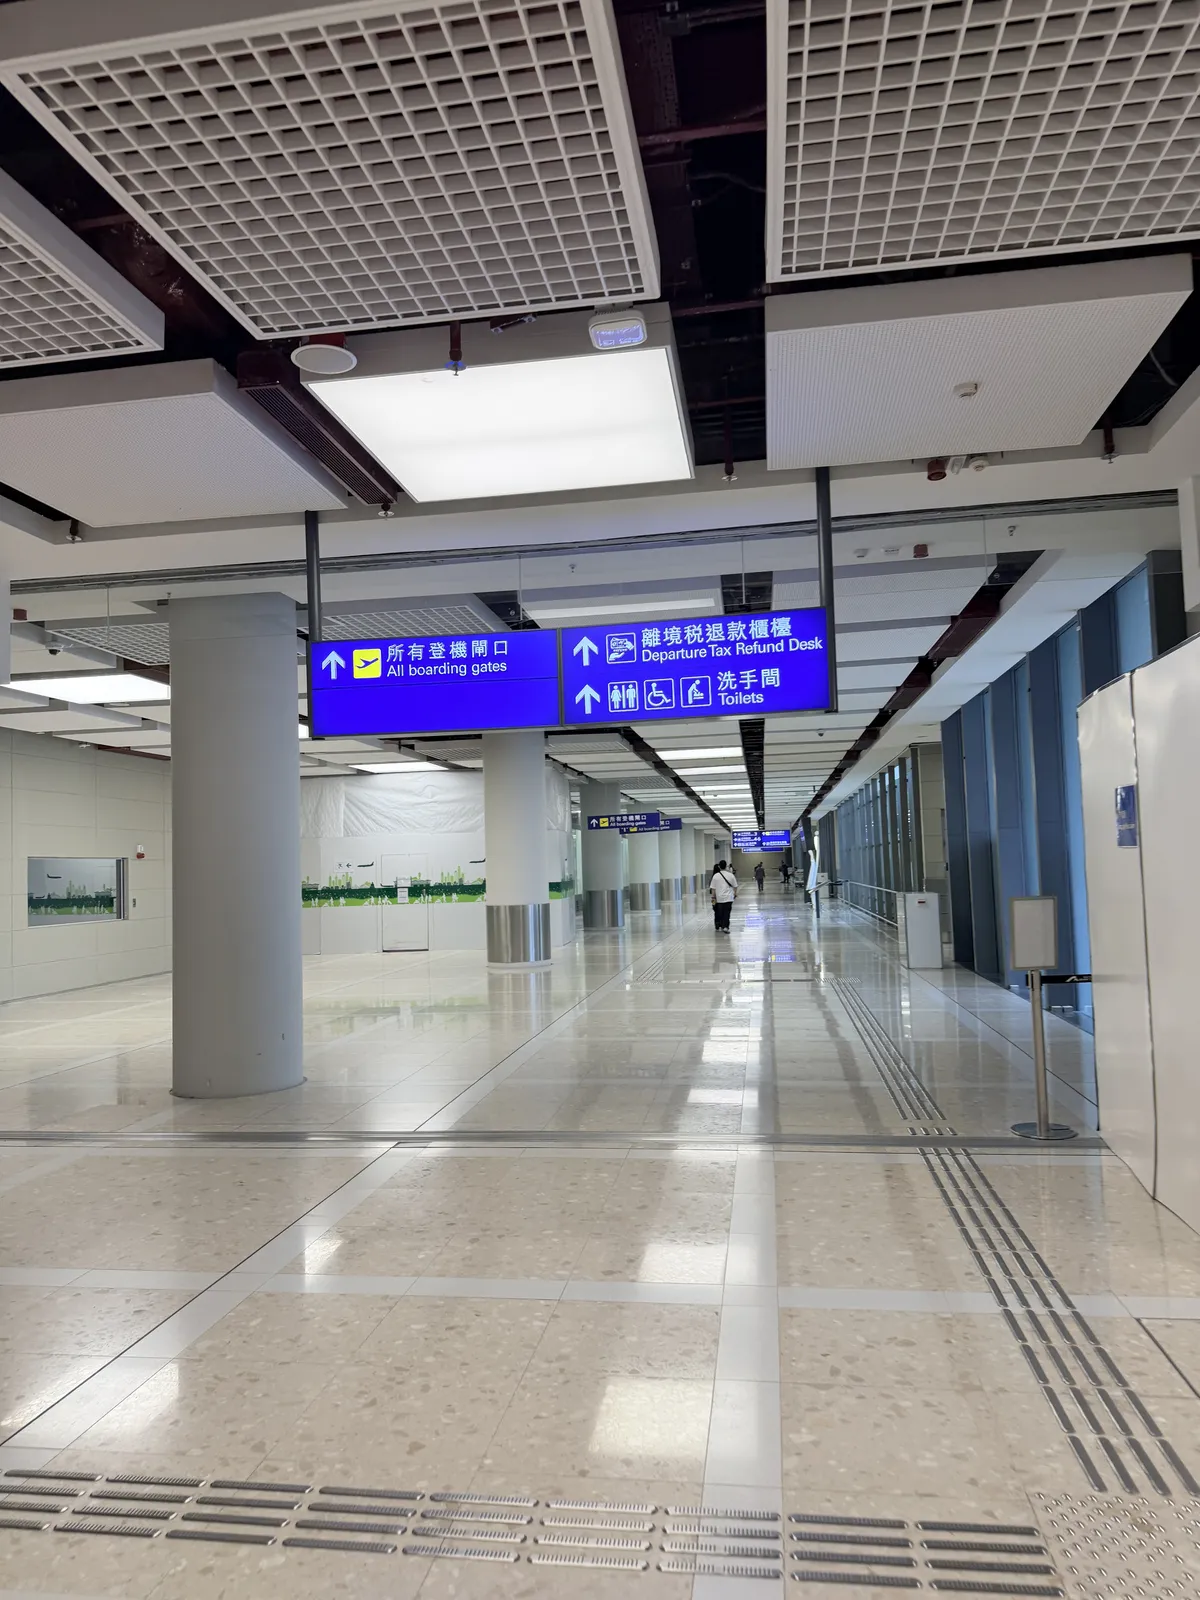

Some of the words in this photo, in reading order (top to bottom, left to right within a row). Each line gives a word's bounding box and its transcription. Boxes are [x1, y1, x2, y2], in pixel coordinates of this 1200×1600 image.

[386, 640, 508, 662] 所有登機閘口
[642, 647, 707, 663] Departure
[707, 644, 731, 657] Tax
[736, 639, 784, 655] Refund
[789, 636, 823, 651] Desk
[386, 664, 405, 677] All
[409, 662, 467, 676] boarding
[471, 661, 507, 675] gates
[717, 668, 780, 691] 洗手間
[718, 691, 764, 706] Toilets
